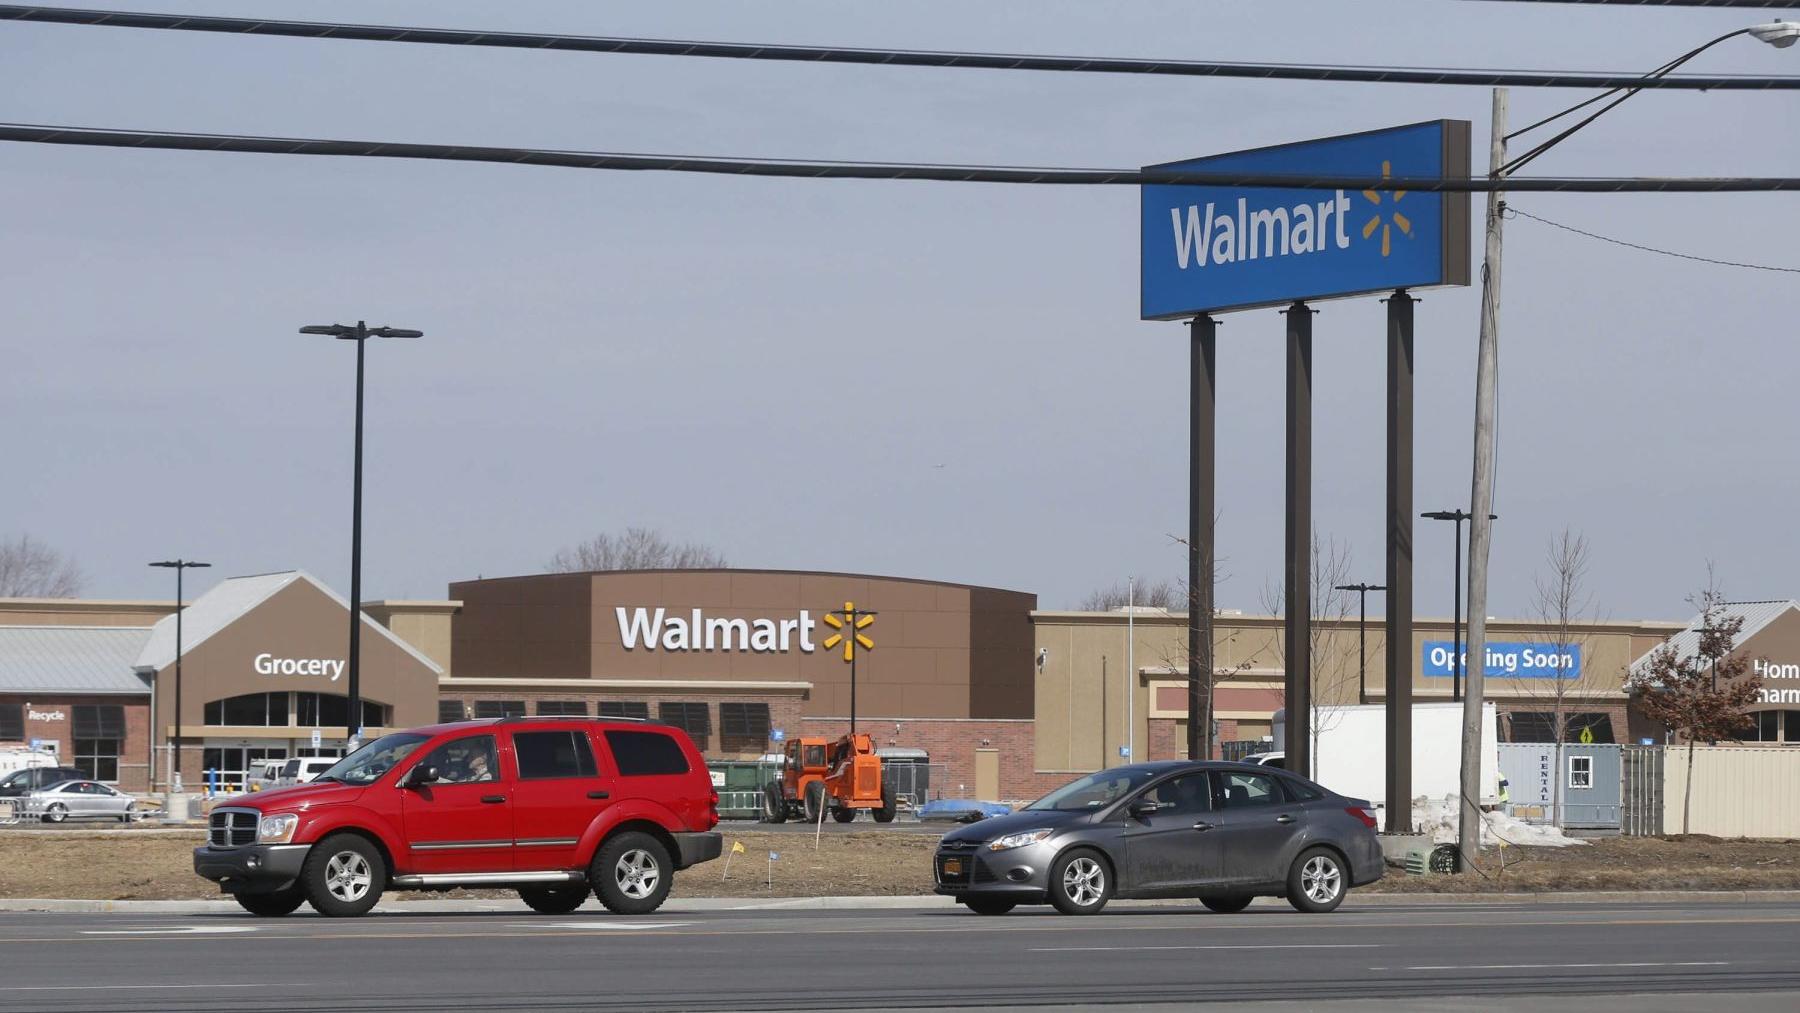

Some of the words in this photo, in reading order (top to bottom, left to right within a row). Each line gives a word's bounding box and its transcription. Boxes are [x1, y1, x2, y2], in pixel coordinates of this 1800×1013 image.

[1171, 188, 1350, 269] Walmart
[615, 607, 815, 652] Walmart
[254, 653, 345, 681] Grocery
[1522, 649, 1573, 669] Soon
[28, 710, 65, 722] Recycle
[1541, 755, 1549, 801] RENTAL
